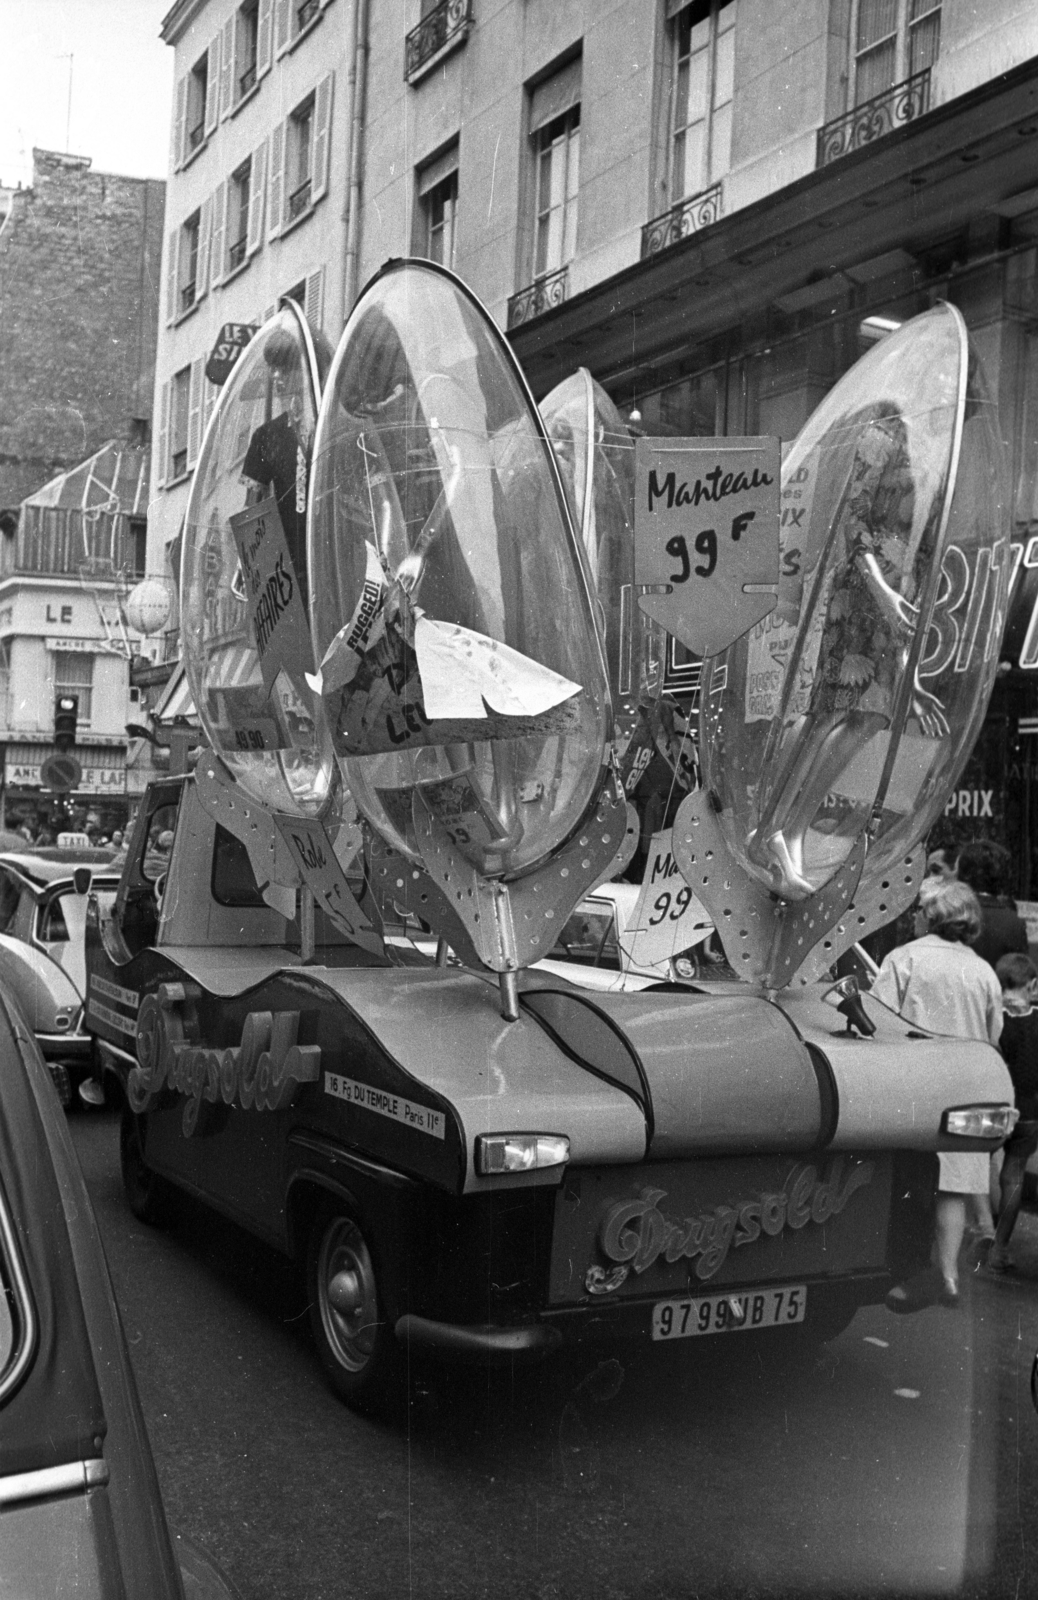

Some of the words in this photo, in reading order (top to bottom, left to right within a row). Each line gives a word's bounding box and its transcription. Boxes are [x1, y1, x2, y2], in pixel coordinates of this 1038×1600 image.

[224, 325, 242, 343] LE
[649, 465, 773, 512] Manteau
[666, 529, 717, 583] 99
[731, 511, 756, 541] F
[45, 604, 73, 624] LE
[347, 579, 381, 650] RUGGED!
[651, 852, 680, 885] Ma
[649, 886, 693, 926] 99
[354, 1085, 365, 1103] DU
[366, 1089, 398, 1116] TEMPLE
[405, 1104, 424, 1126] Paris
[659, 1300, 728, 1337] 9799
[774, 1290, 801, 1322] 75
